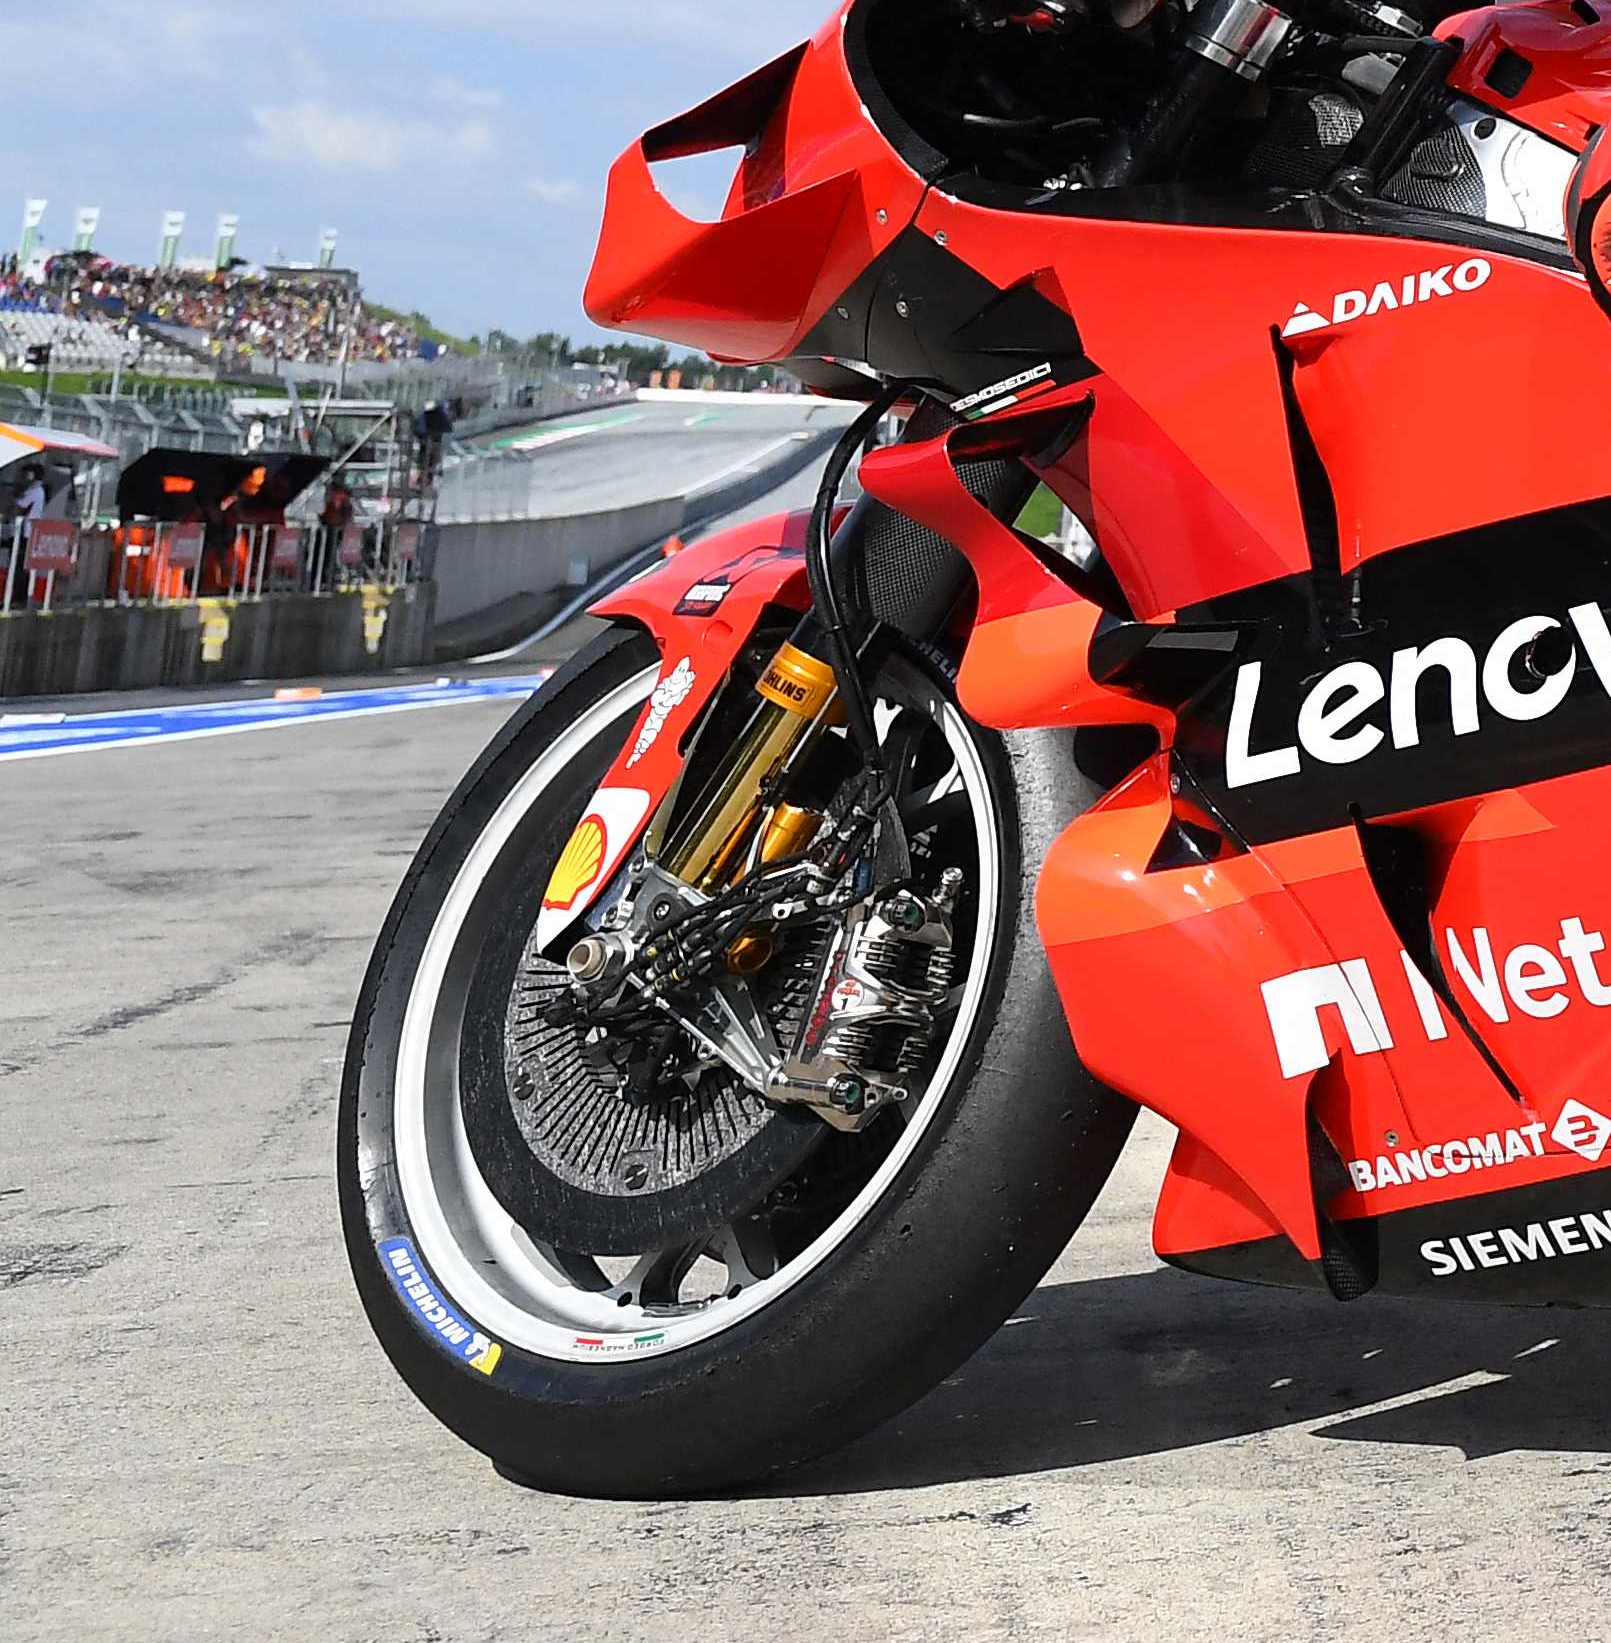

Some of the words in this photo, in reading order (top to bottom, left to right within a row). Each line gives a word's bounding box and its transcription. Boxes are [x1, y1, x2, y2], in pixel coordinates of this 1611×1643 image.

[1332, 258, 1492, 324] DAIKO
[1349, 1123, 1547, 1192] BANCOMAT
[389, 1246, 470, 1345] MICHELIN
